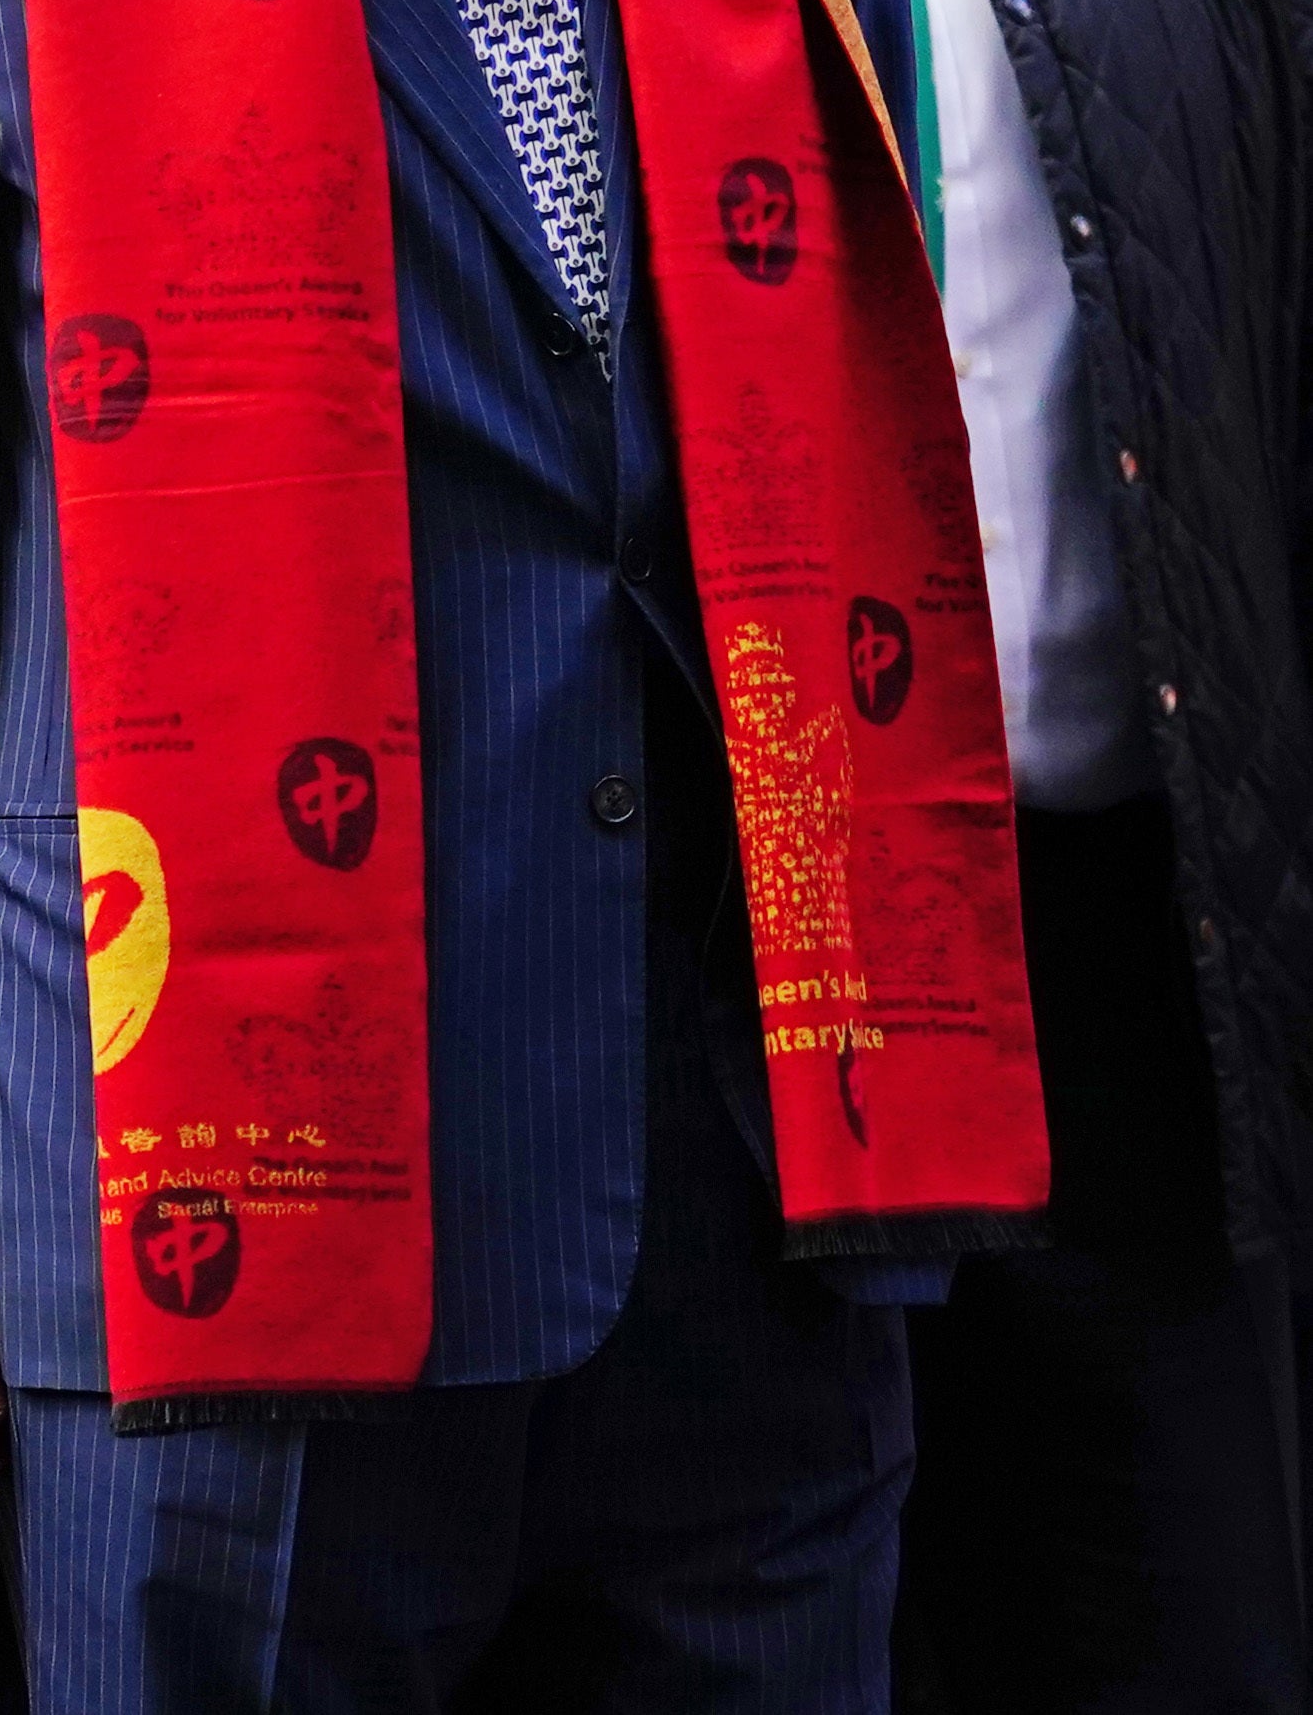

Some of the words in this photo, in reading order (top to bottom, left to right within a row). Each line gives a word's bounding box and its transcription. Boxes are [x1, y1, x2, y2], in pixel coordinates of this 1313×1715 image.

[107, 1169, 149, 1198] and
[158, 1166, 242, 1190] Advice
[247, 1164, 328, 1188] Centre
